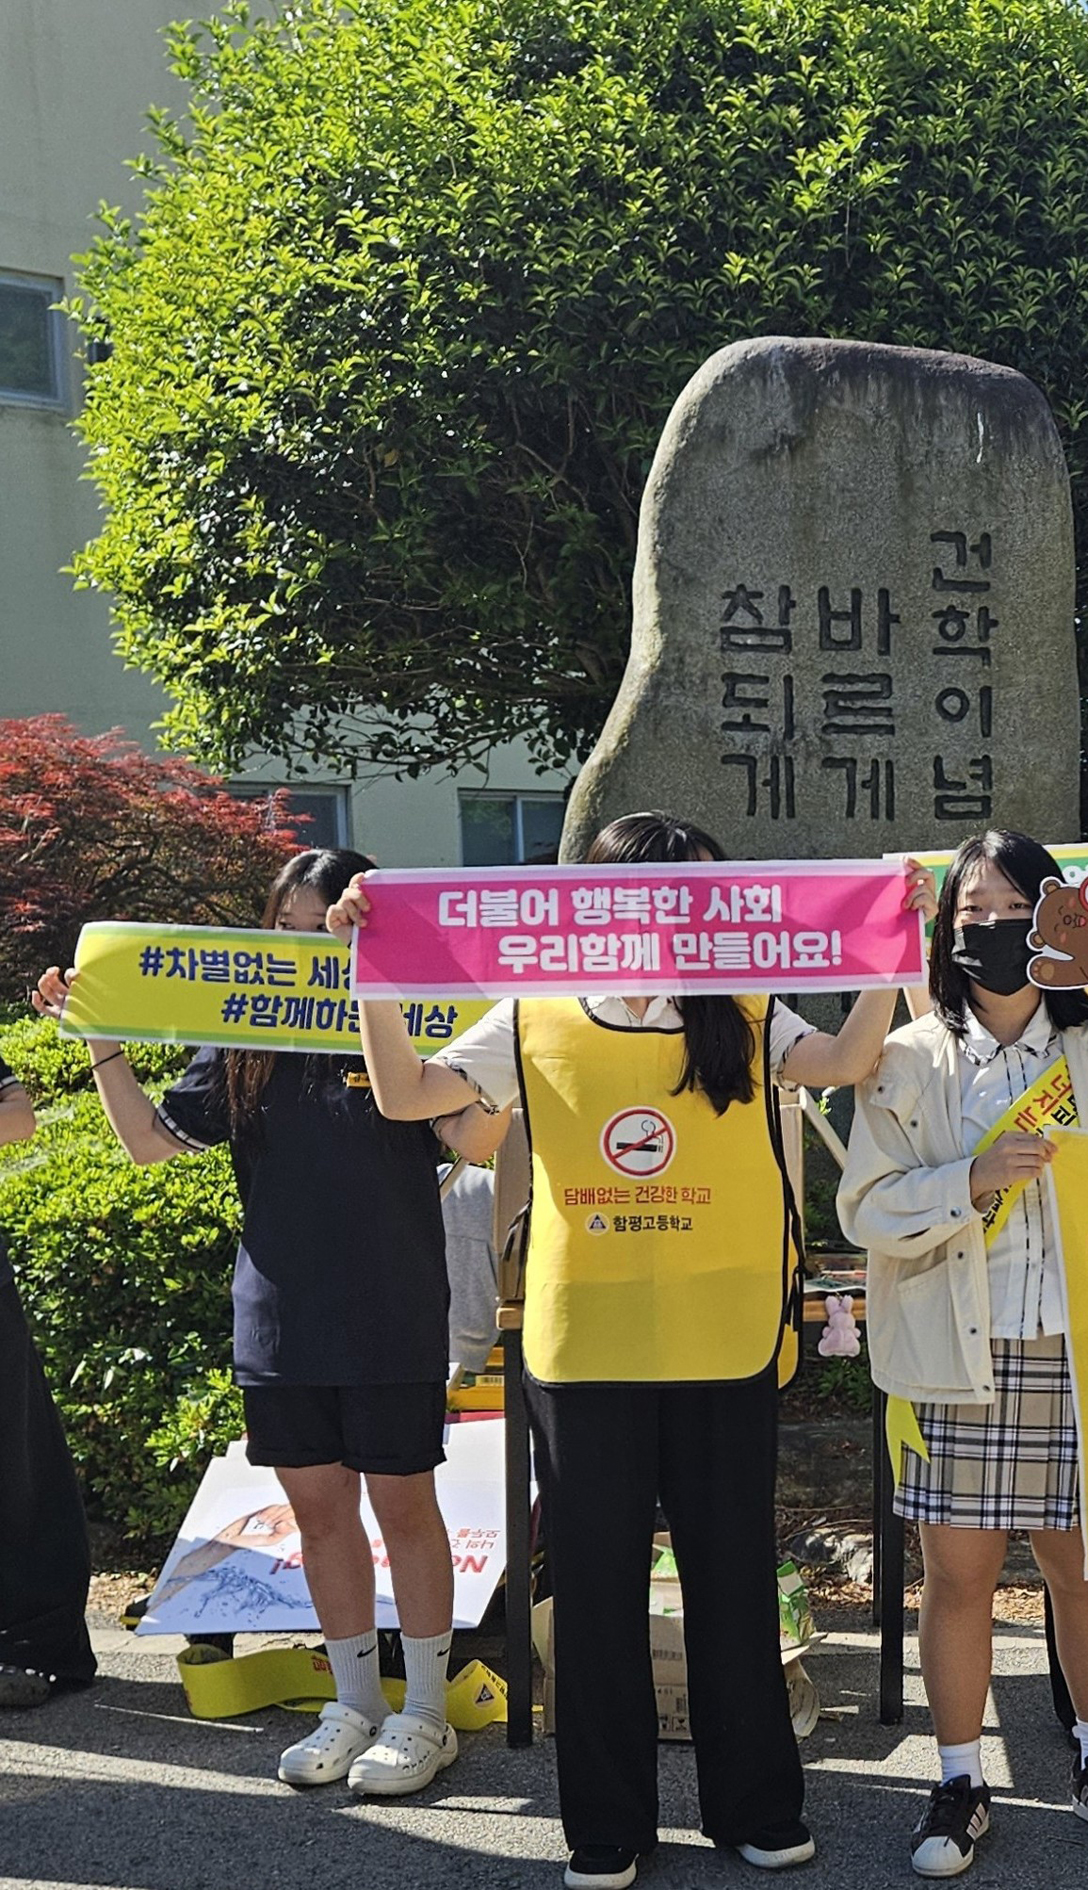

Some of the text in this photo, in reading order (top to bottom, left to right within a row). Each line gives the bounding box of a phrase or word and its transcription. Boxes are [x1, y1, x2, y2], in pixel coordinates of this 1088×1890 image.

[719, 583, 797, 820] 참되게
[818, 585, 901, 822] 바르게
[438, 885, 783, 929] 더불어 행복한 사회
[138, 944, 299, 988] #차별없는
[498, 930, 842, 974] 우리함께 만들어요!
[1013, 1064, 1073, 1132] 너지는
[564, 1186, 712, 1206] 담배없는 건강한 학교
[612, 1214, 694, 1233] 함평고등학교
